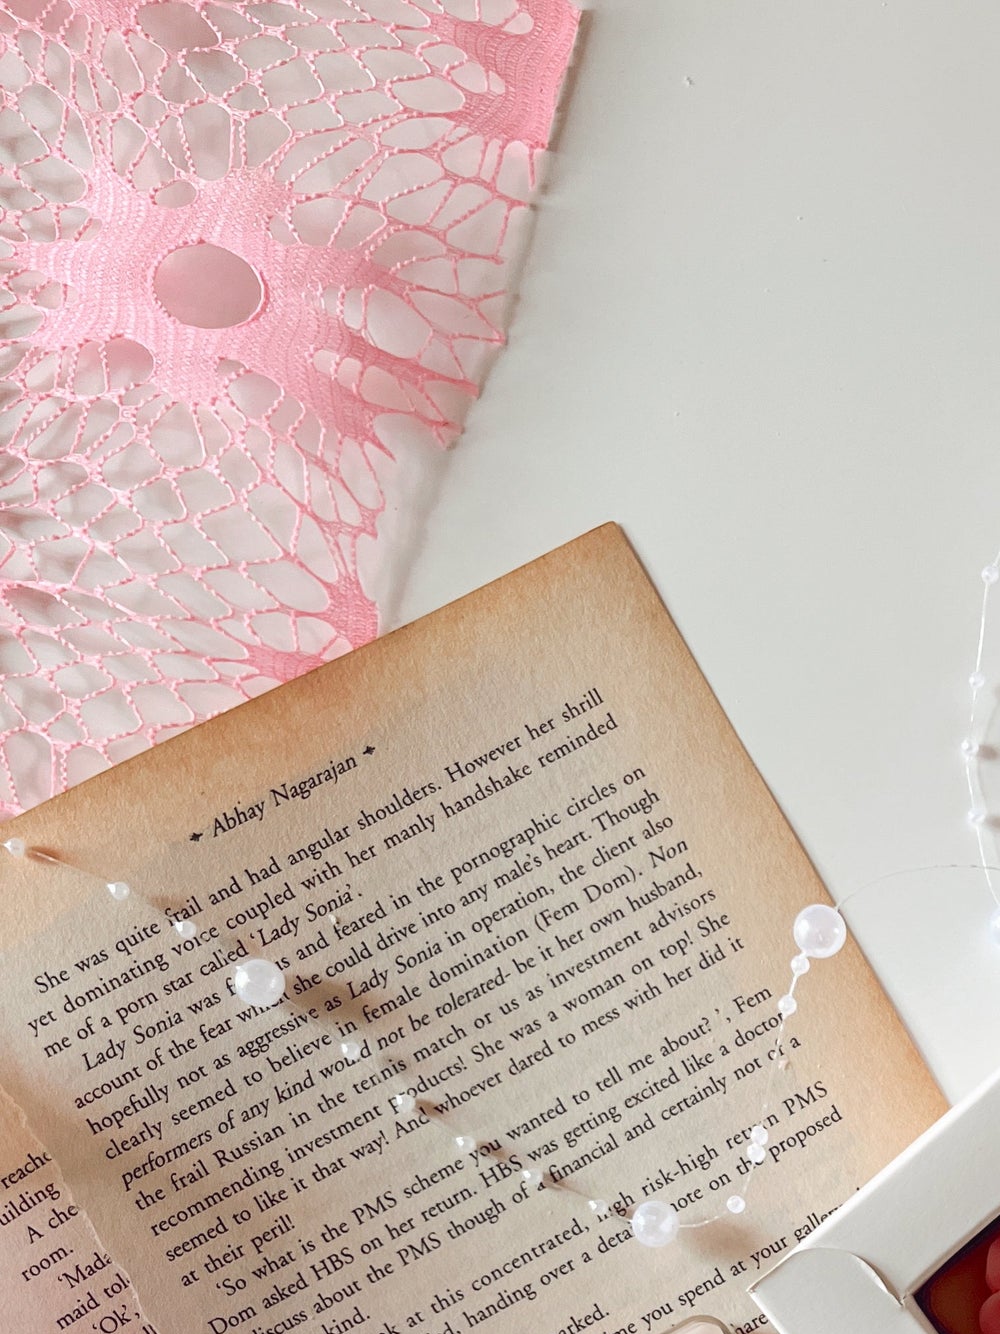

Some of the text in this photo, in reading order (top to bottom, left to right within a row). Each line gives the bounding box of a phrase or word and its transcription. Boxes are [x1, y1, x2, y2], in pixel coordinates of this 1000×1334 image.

[33, 686, 604, 994] She quite frail angular shoulders. However shrill
[62, 711, 619, 1014] dominating voice coupled with manly handshake reminded
[80, 782, 618, 1072] Lady feared pornographic circles
[211, 755, 358, 838] Abhay Nagarajan
[73, 1065, 143, 1110] account
[198, 1017, 234, 1043] fear
[324, 939, 374, 978] could
[375, 921, 419, 951] drive
[417, 902, 456, 928] into
[540, 830, 592, 861] heart.
[589, 787, 661, 832] Though
[84, 815, 674, 1136] hopefully aggressive Lady Sonia operation, client also
[104, 839, 689, 1160] clearly seemed believe female domination (Fem Dom). Non
[114, 991, 159, 1026] porn
[161, 970, 195, 996] star
[198, 938, 250, 977] called
[120, 861, 703, 1192] performers kind tolerated- husband,
[169, 1157, 211, 1193] frail
[211, 1124, 286, 1169] Russian
[411, 1023, 468, 1063] match
[545, 929, 643, 989] investment
[647, 888, 717, 934] advisors
[149, 972, 626, 1237] recommending investment woman
[164, 980, 662, 1262] seemed like that dared mess with
[250, 1016, 712, 1280] what PMS scheme wanted tell about?
[260, 1270, 310, 1310] asked
[308, 1245, 355, 1282] HBS
[419, 1187, 478, 1223] return.
[477, 1153, 523, 1189] HBS
[562, 1105, 622, 1149] getting
[623, 1065, 681, 1109] excited
[679, 1052, 715, 1077] like
[312, 1279, 363, 1314] about
[445, 1197, 507, 1240] though
[659, 1075, 727, 1121] certainly
[429, 1287, 465, 1314] this
[470, 1216, 590, 1292] concentrated,
[640, 1143, 720, 1197] risk-high
[461, 1282, 537, 1328] handing
[538, 1258, 576, 1286] over
[767, 1103, 843, 1163] proposed
[20, 1246, 74, 1282] room.
[55, 1290, 101, 1331] maid
[202, 1212, 295, 1274] their peril!
[676, 1266, 727, 1308] spend
[748, 1235, 788, 1270] your
